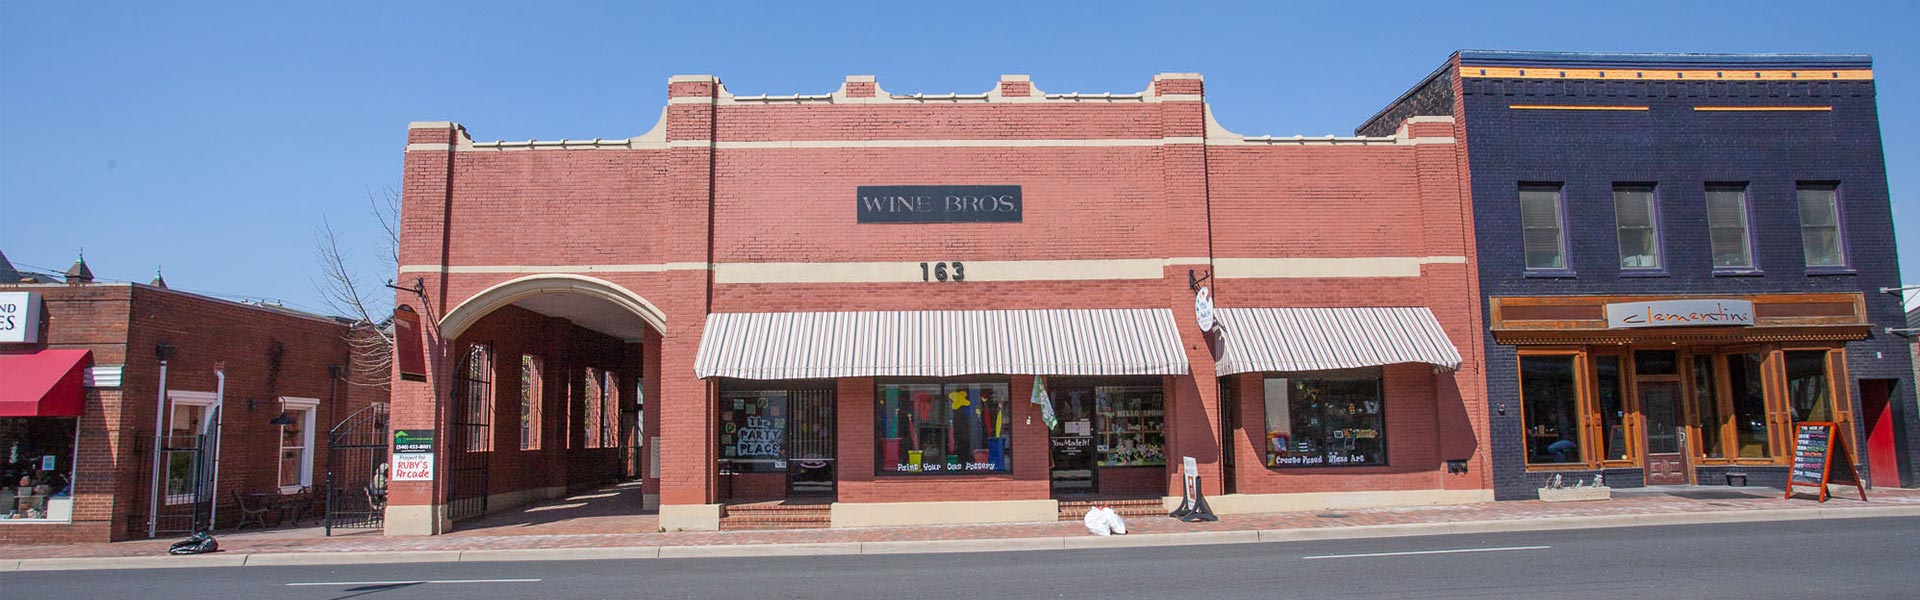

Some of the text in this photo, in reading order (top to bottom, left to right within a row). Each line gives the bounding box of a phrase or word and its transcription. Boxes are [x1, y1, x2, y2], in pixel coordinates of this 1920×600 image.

[863, 195, 1018, 213] WINE BROS.
[920, 262, 965, 283] 163
[740, 430, 780, 442] PARTY
[740, 443, 780, 454] PLACE
[1350, 454, 1365, 462] Art
[398, 461, 428, 469] RUBY'S
[897, 463, 919, 472] Paint
[923, 462, 942, 471] Your
[396, 469, 429, 478] Arcade
